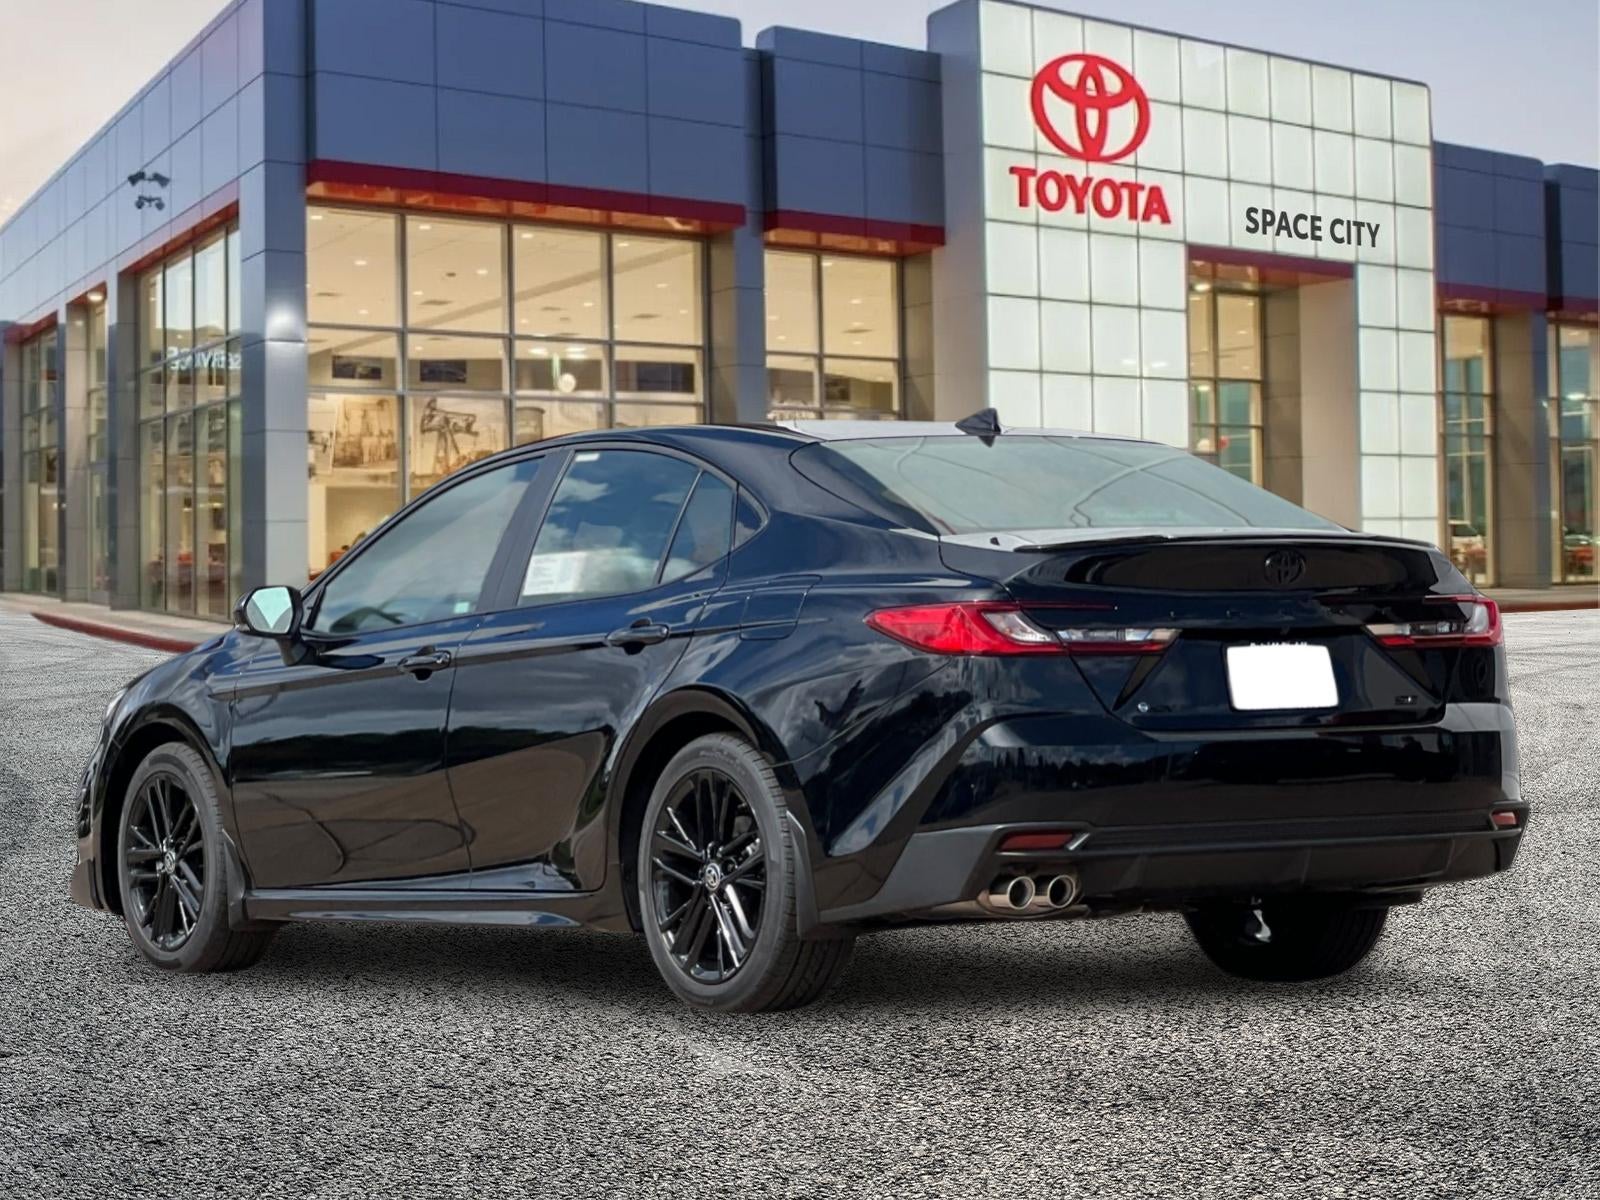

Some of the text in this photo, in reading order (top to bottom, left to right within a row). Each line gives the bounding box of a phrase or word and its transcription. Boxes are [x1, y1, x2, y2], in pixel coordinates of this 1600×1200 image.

[1009, 166, 1171, 224] TOYOTA
[1246, 207, 1379, 247] SPACE CITY
